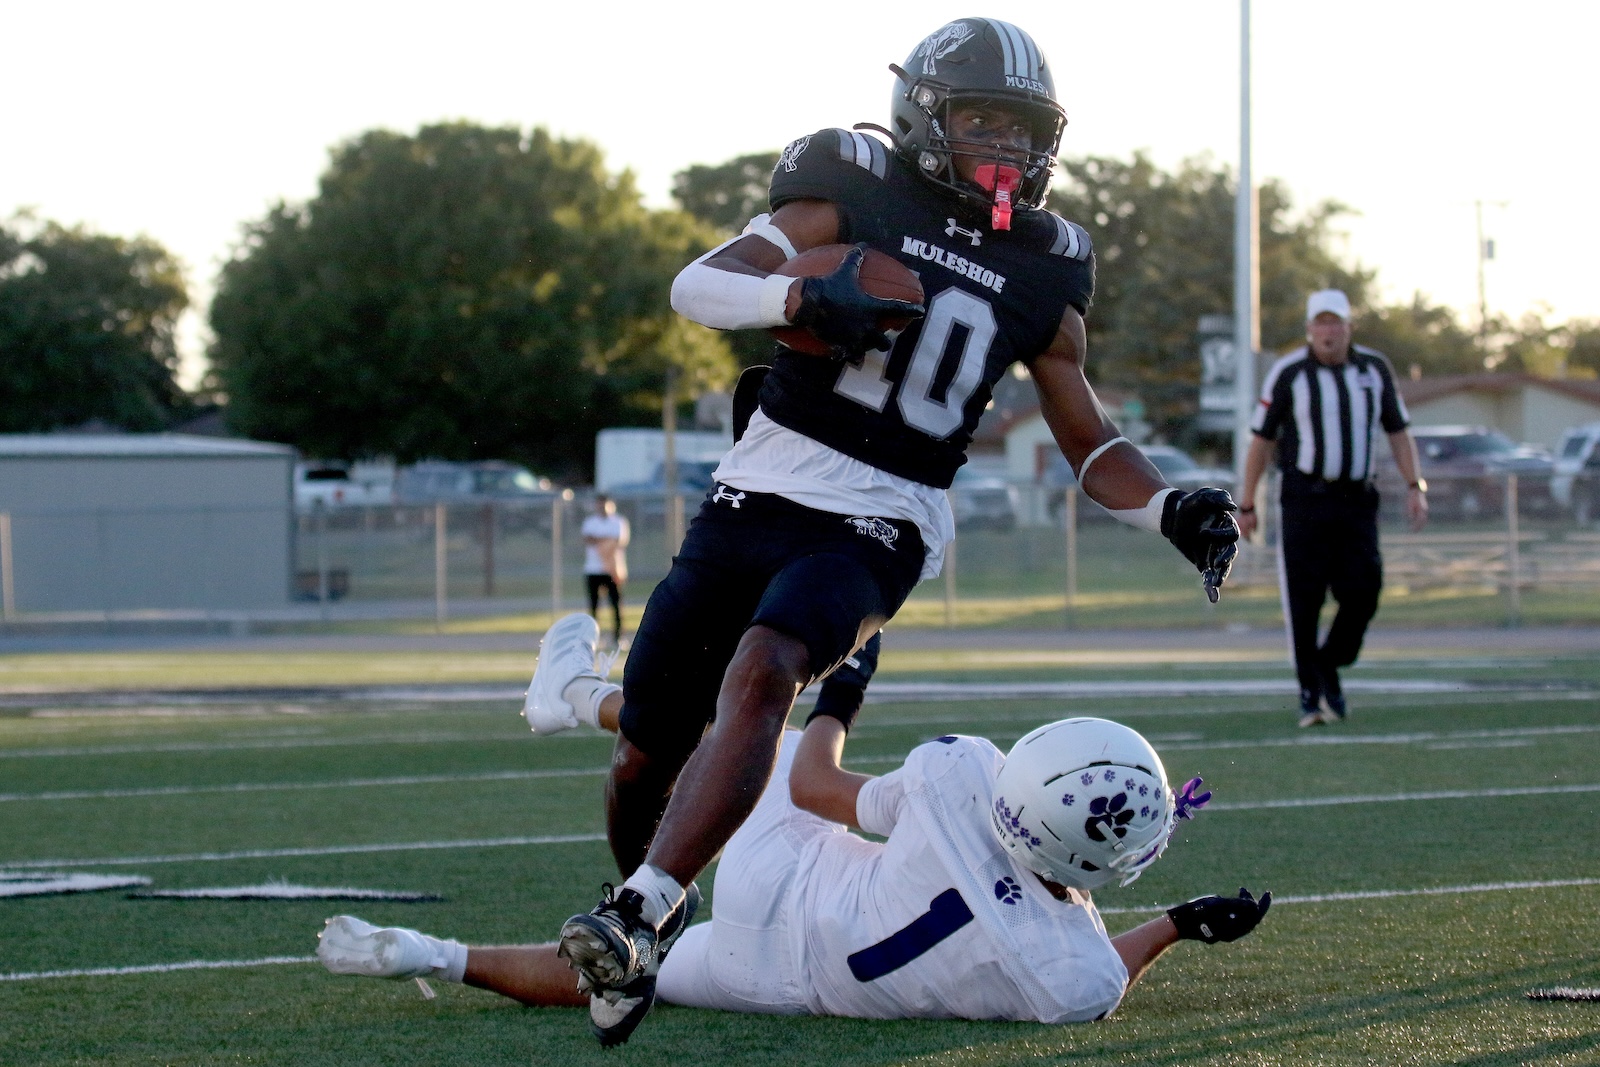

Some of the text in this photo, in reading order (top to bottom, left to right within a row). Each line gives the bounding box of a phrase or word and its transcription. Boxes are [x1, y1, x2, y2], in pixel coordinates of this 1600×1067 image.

[901, 236, 1006, 294] MULESHOE
[833, 269, 999, 441] 10
[847, 887, 975, 983] 1
